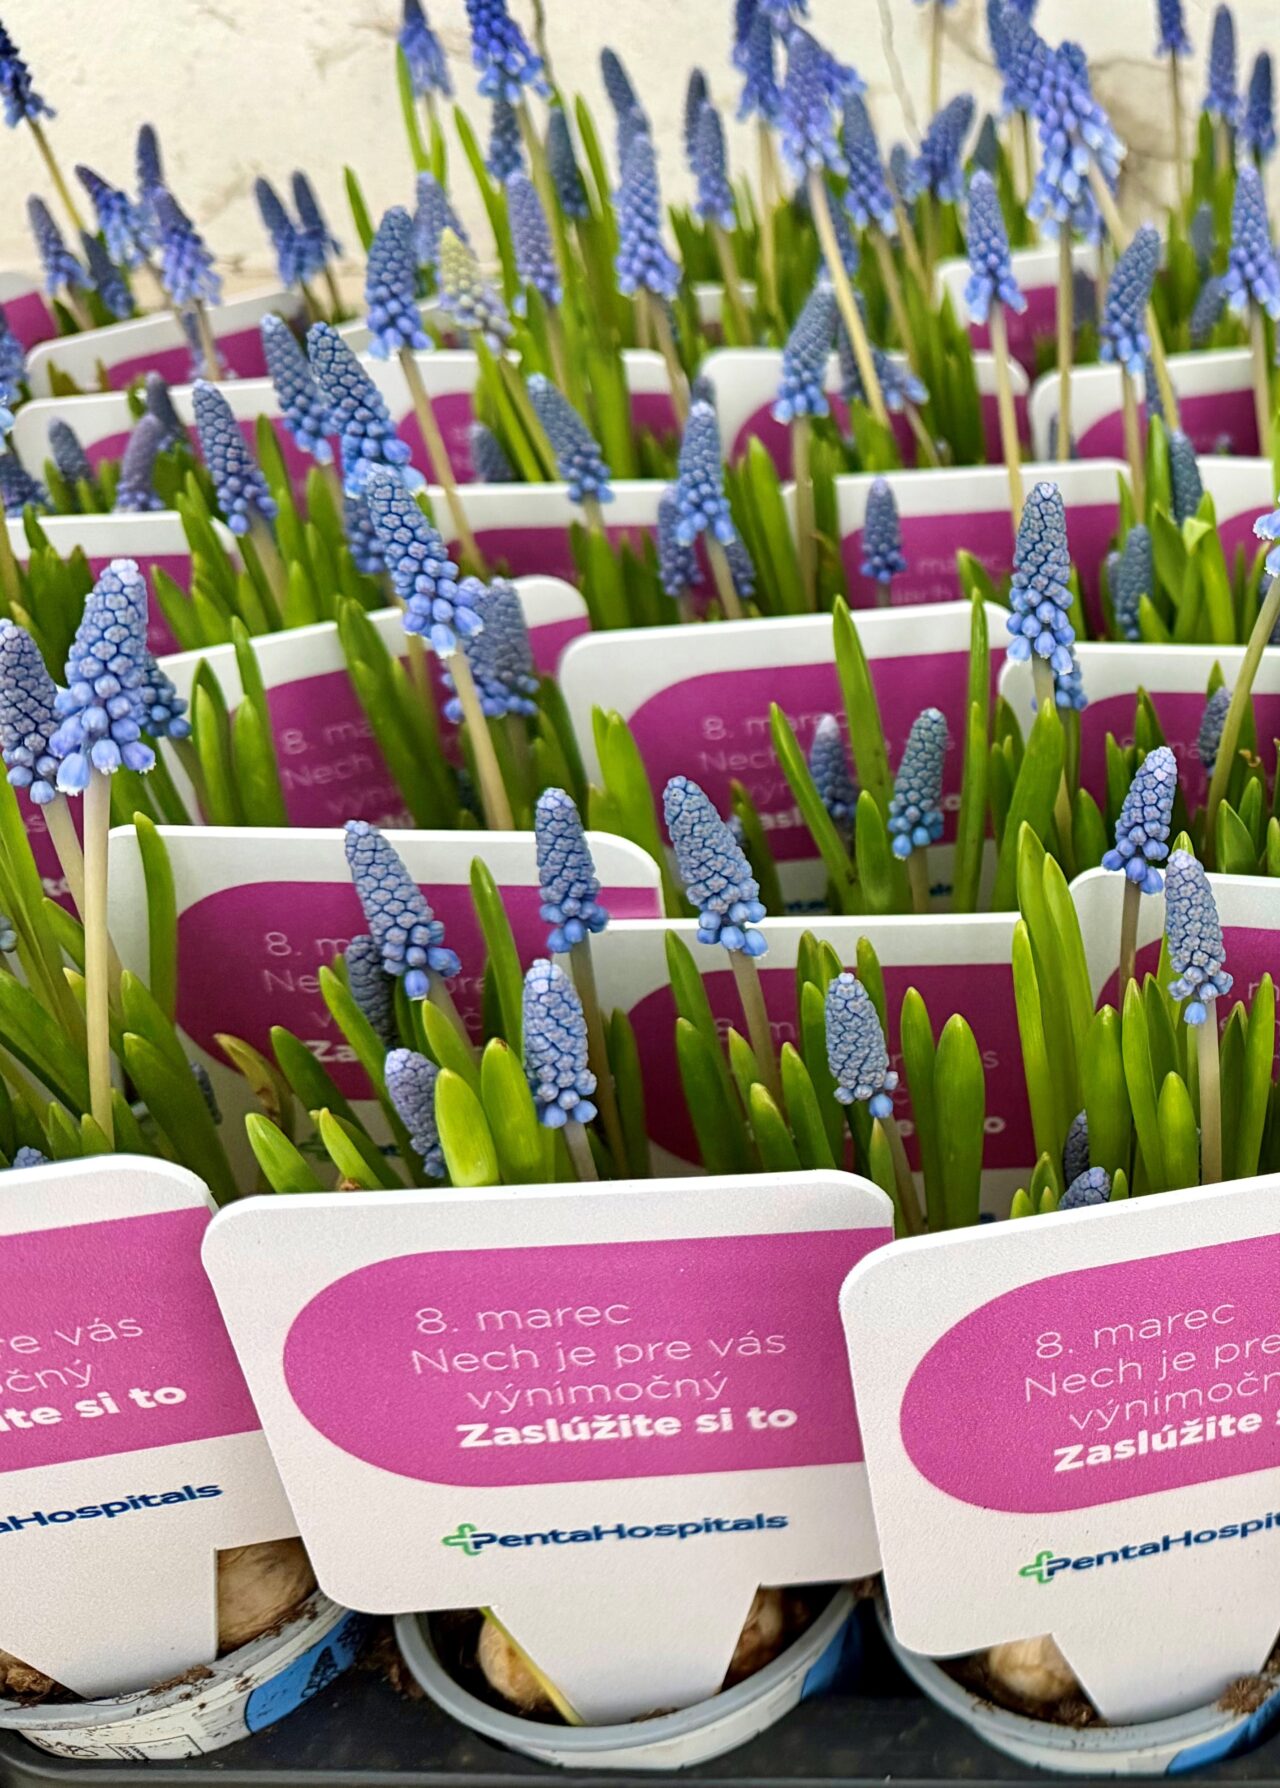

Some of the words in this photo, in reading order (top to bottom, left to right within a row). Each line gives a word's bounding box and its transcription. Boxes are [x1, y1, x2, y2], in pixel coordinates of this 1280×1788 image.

[54, 1317, 144, 1347] vás
[416, 1308, 459, 1334] 8.
[477, 1303, 632, 1331] marec
[1035, 1332, 1074, 1359] 8.
[1093, 1304, 1236, 1349] marec
[411, 1343, 540, 1374] Nech
[556, 1341, 598, 1372] je
[613, 1340, 693, 1368] pre
[708, 1330, 788, 1358] vás
[0, 1360, 92, 1392] čný
[466, 1371, 730, 1414] výnimočný
[1025, 1358, 1143, 1402] Nech
[1158, 1349, 1198, 1382] je
[75, 1391, 121, 1418] si
[128, 1386, 188, 1409] to
[456, 1412, 682, 1448] Zaslúžite
[695, 1407, 734, 1434] si
[747, 1406, 799, 1430] to
[1053, 1412, 1264, 1473] Zaslúžite
[471, 1514, 790, 1550] PentaHospitals
